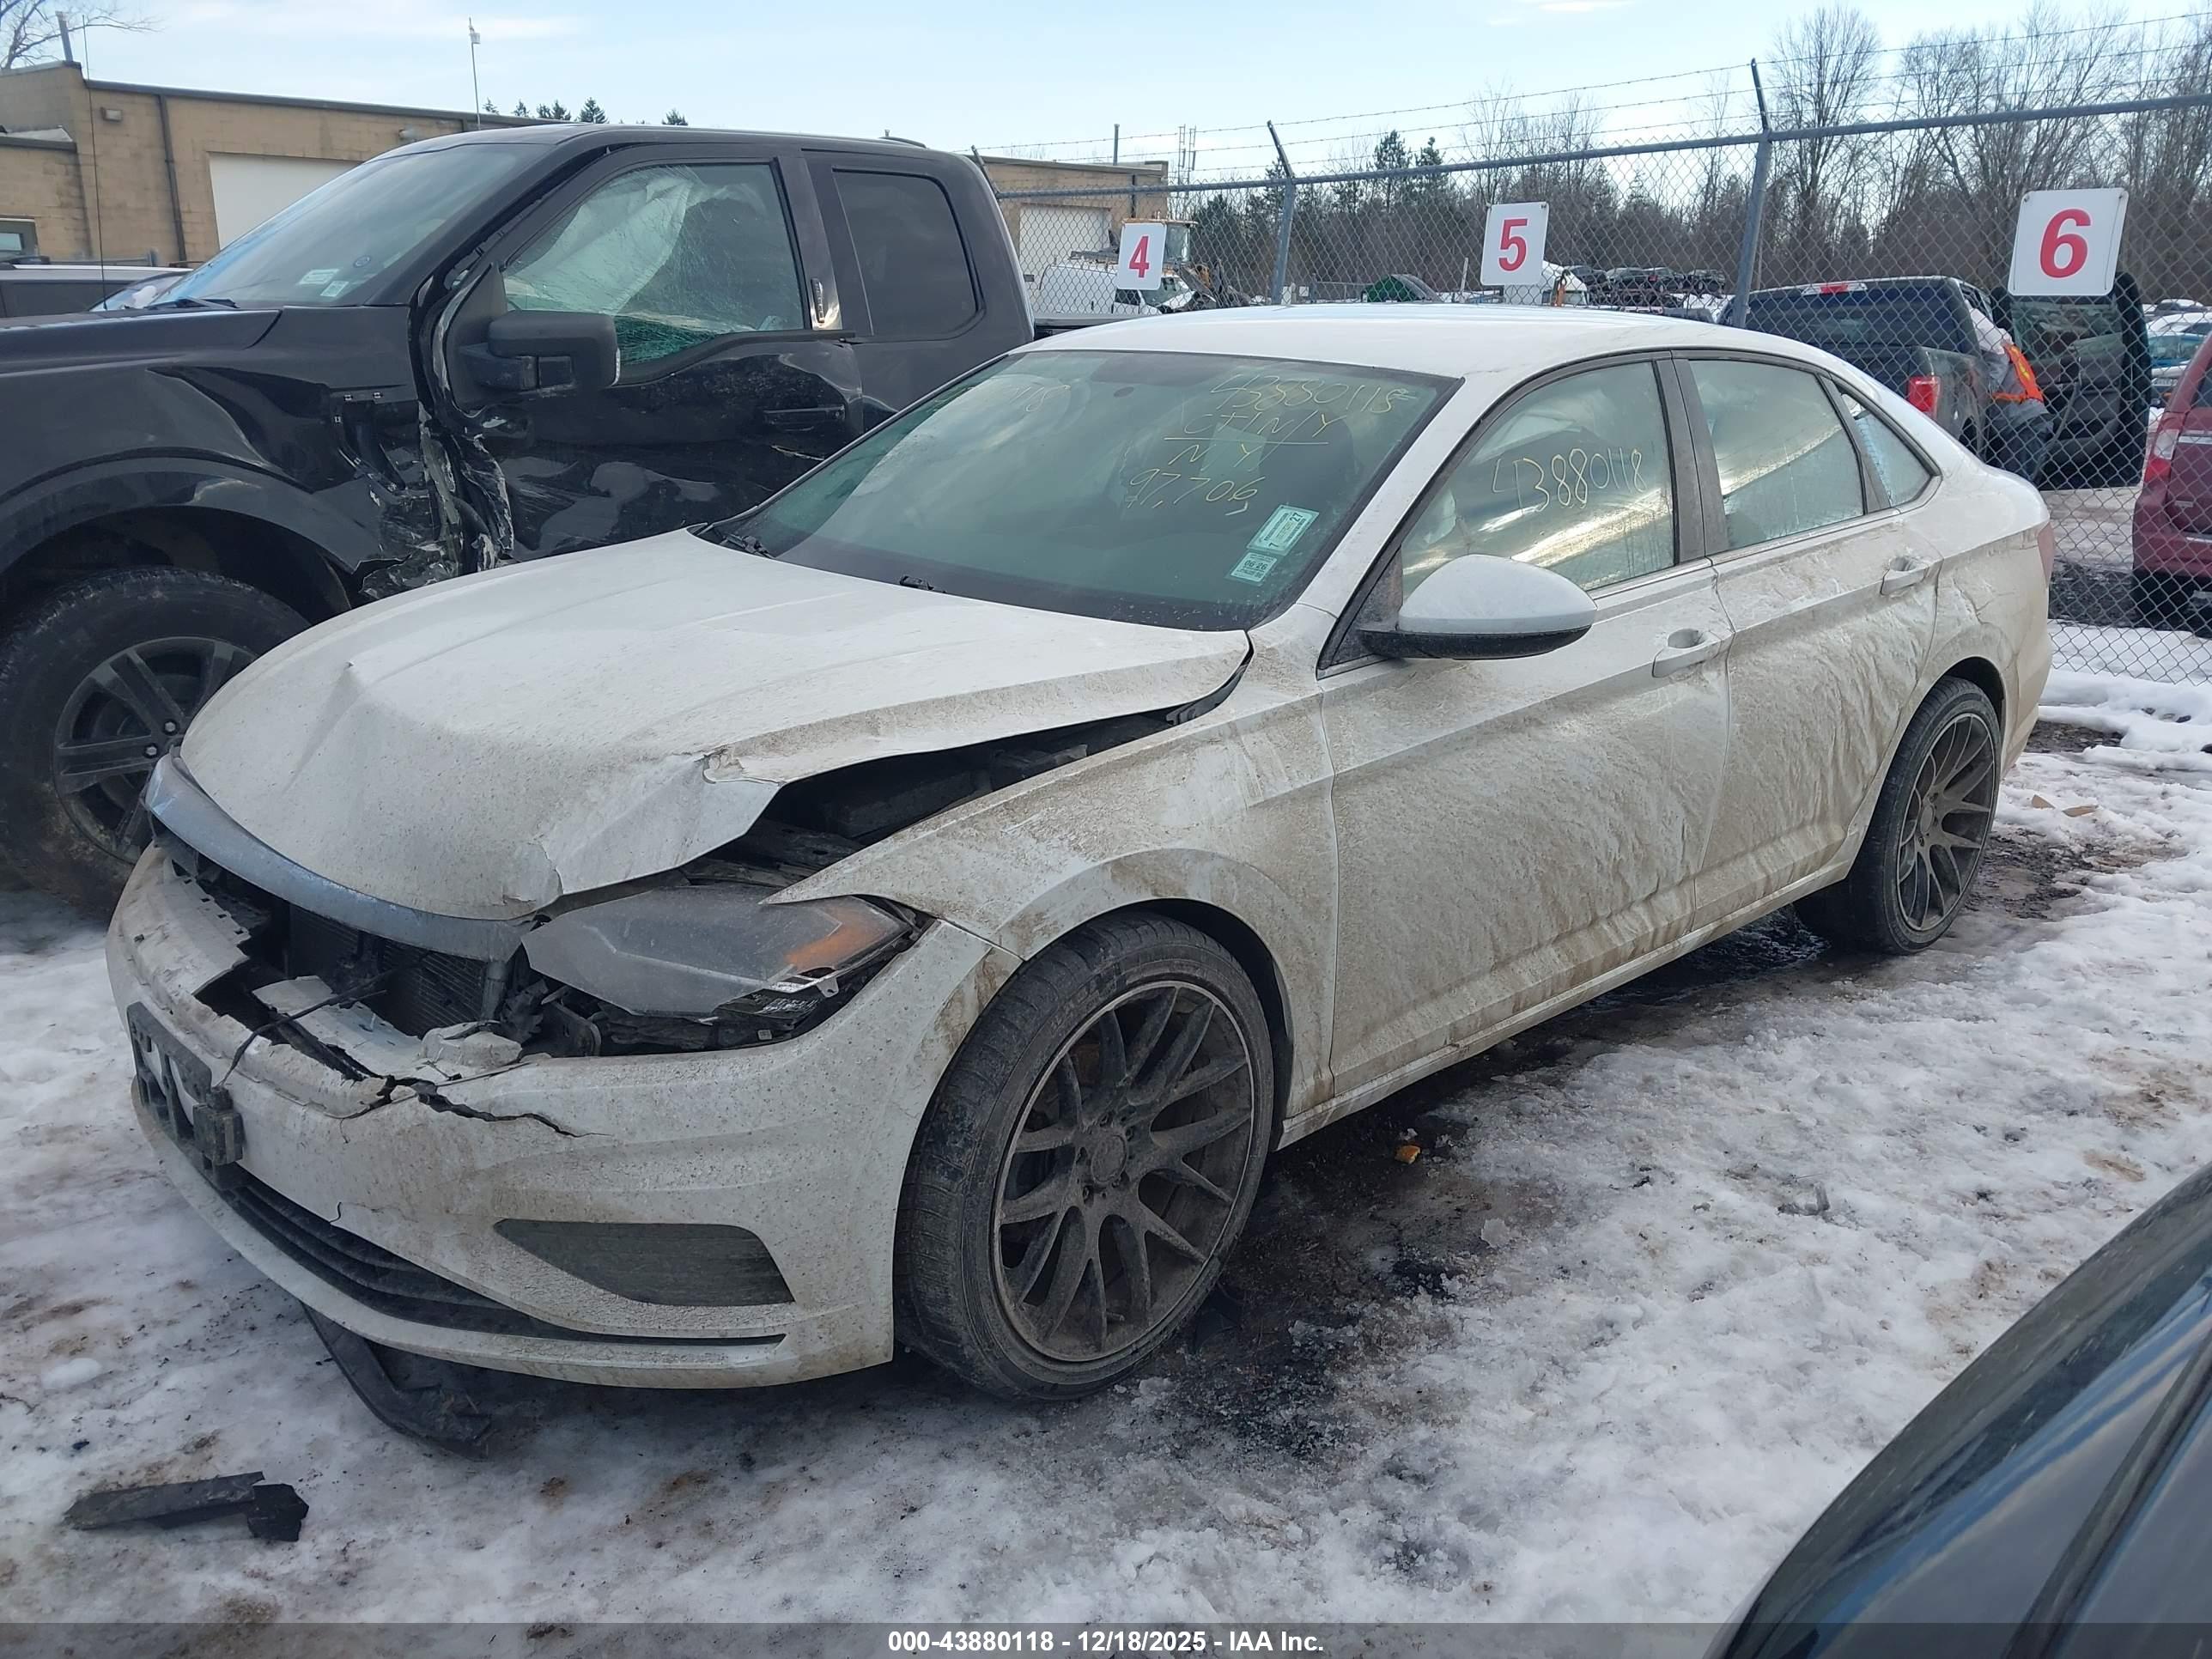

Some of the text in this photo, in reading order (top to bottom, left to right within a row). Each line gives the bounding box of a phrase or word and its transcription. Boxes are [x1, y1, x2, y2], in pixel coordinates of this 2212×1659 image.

[1129, 235, 1150, 277] 4
[1498, 218, 1528, 271] 5
[2040, 209, 2091, 278] 6
